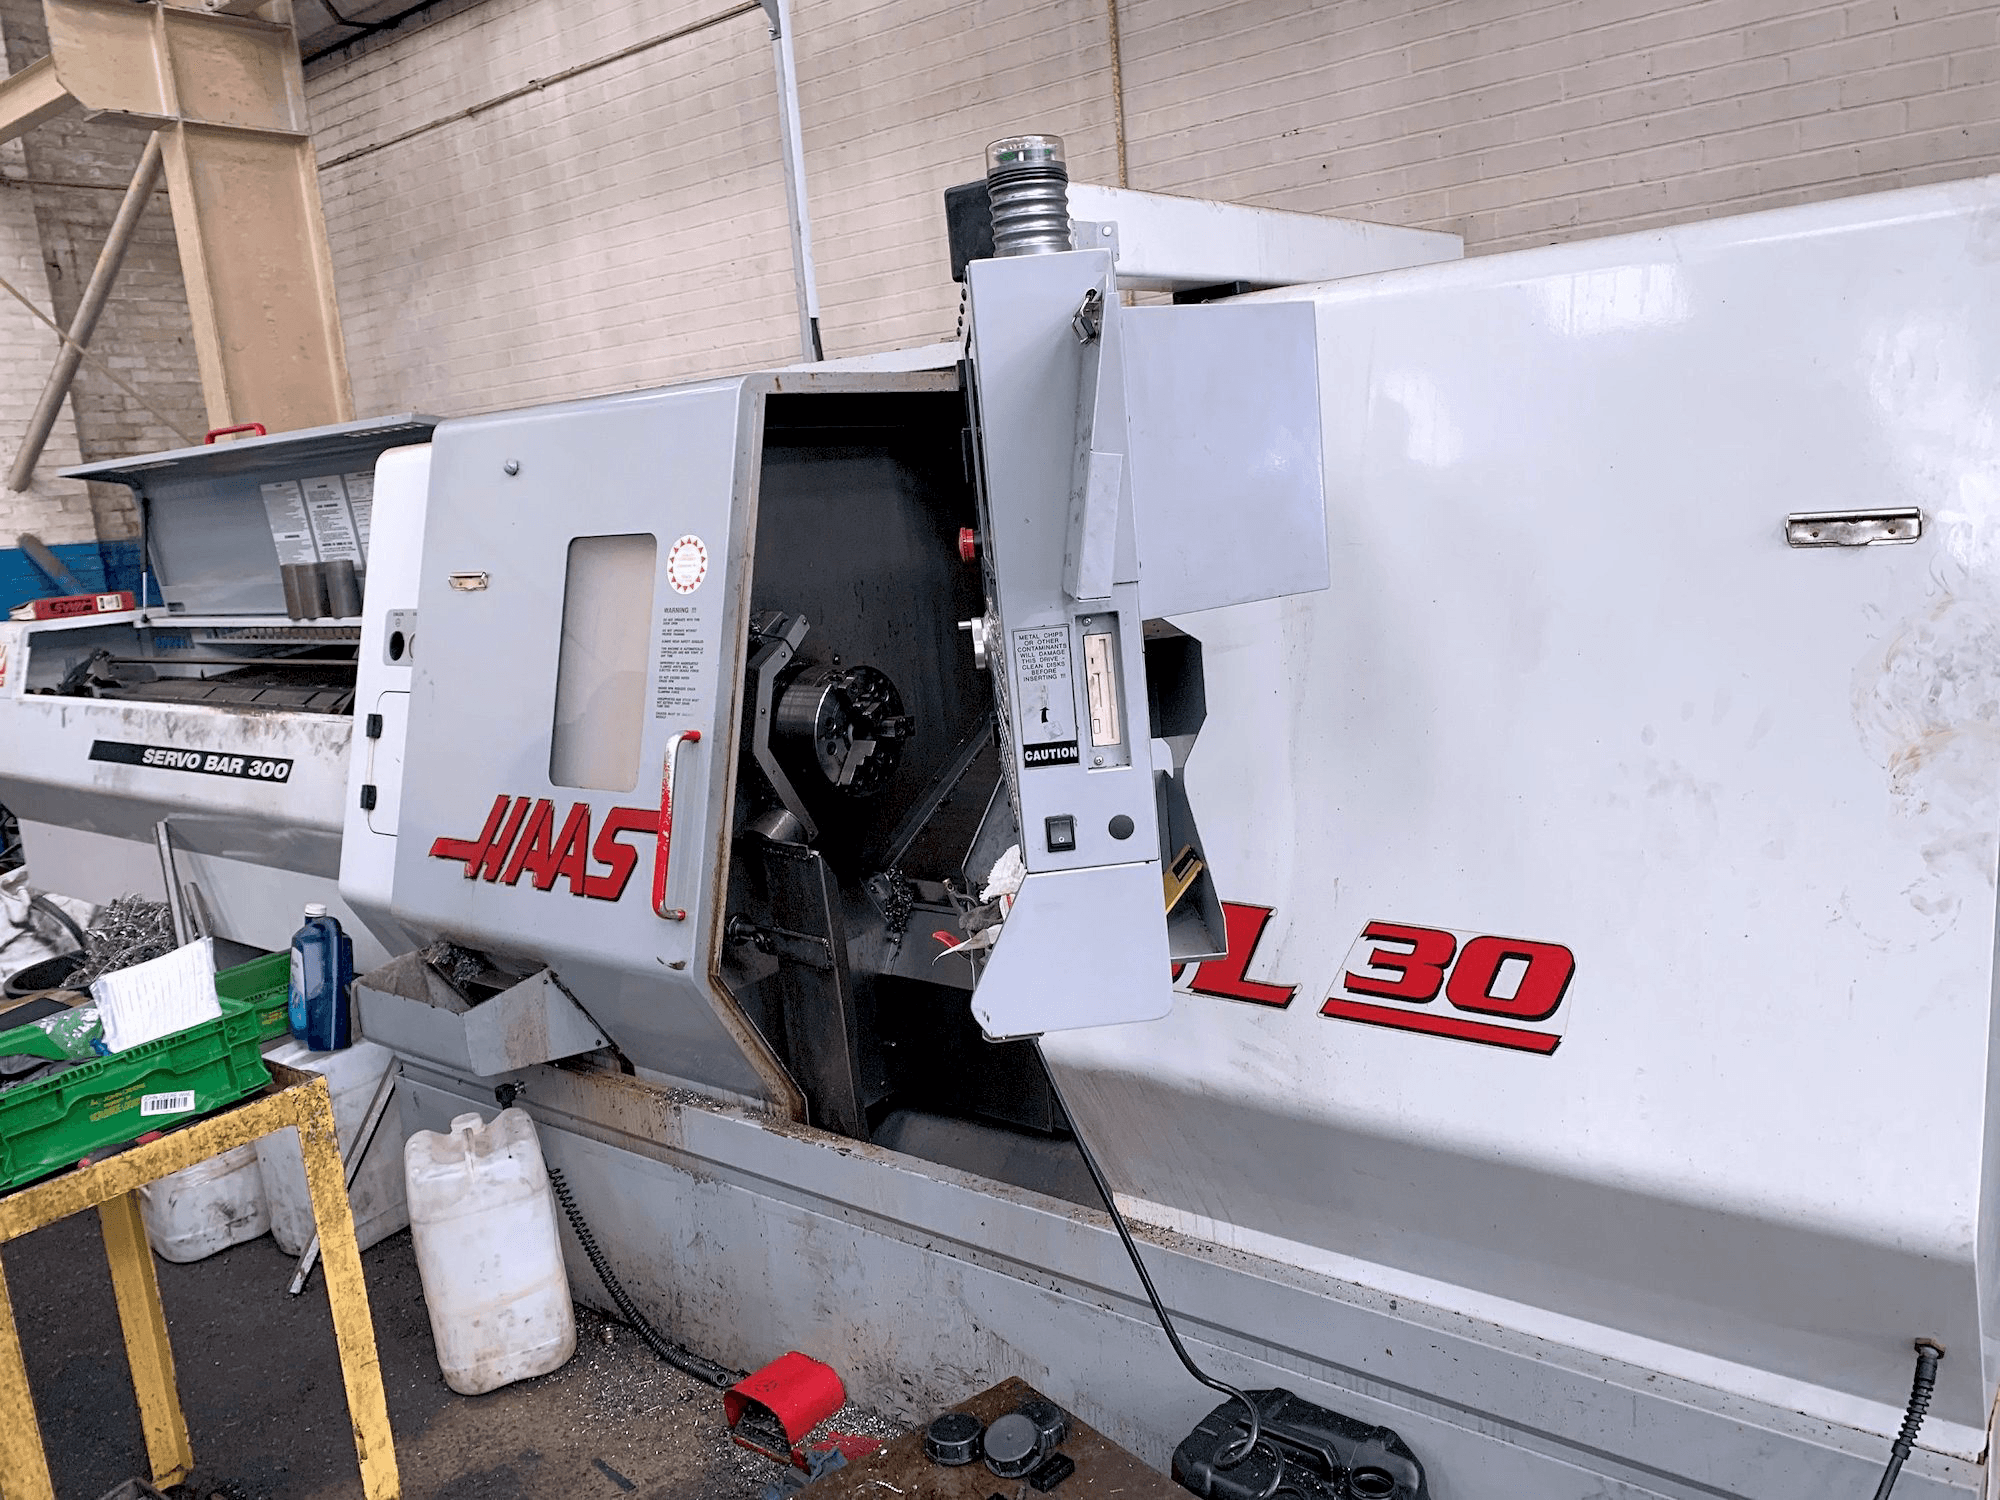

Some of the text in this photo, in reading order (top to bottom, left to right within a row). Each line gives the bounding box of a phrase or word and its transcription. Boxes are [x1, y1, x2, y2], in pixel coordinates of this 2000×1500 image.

[1017, 643, 1067, 653] CONTAMINANTS
[1039, 649, 1065, 657] DAMAGE
[1024, 674, 1057, 682] INSERTING
[1024, 746, 1078, 761] CAUTION
[142, 748, 289, 779] SERVO BAR 300
[428, 794, 662, 902] HAAS
[1344, 921, 1576, 1021] 30
